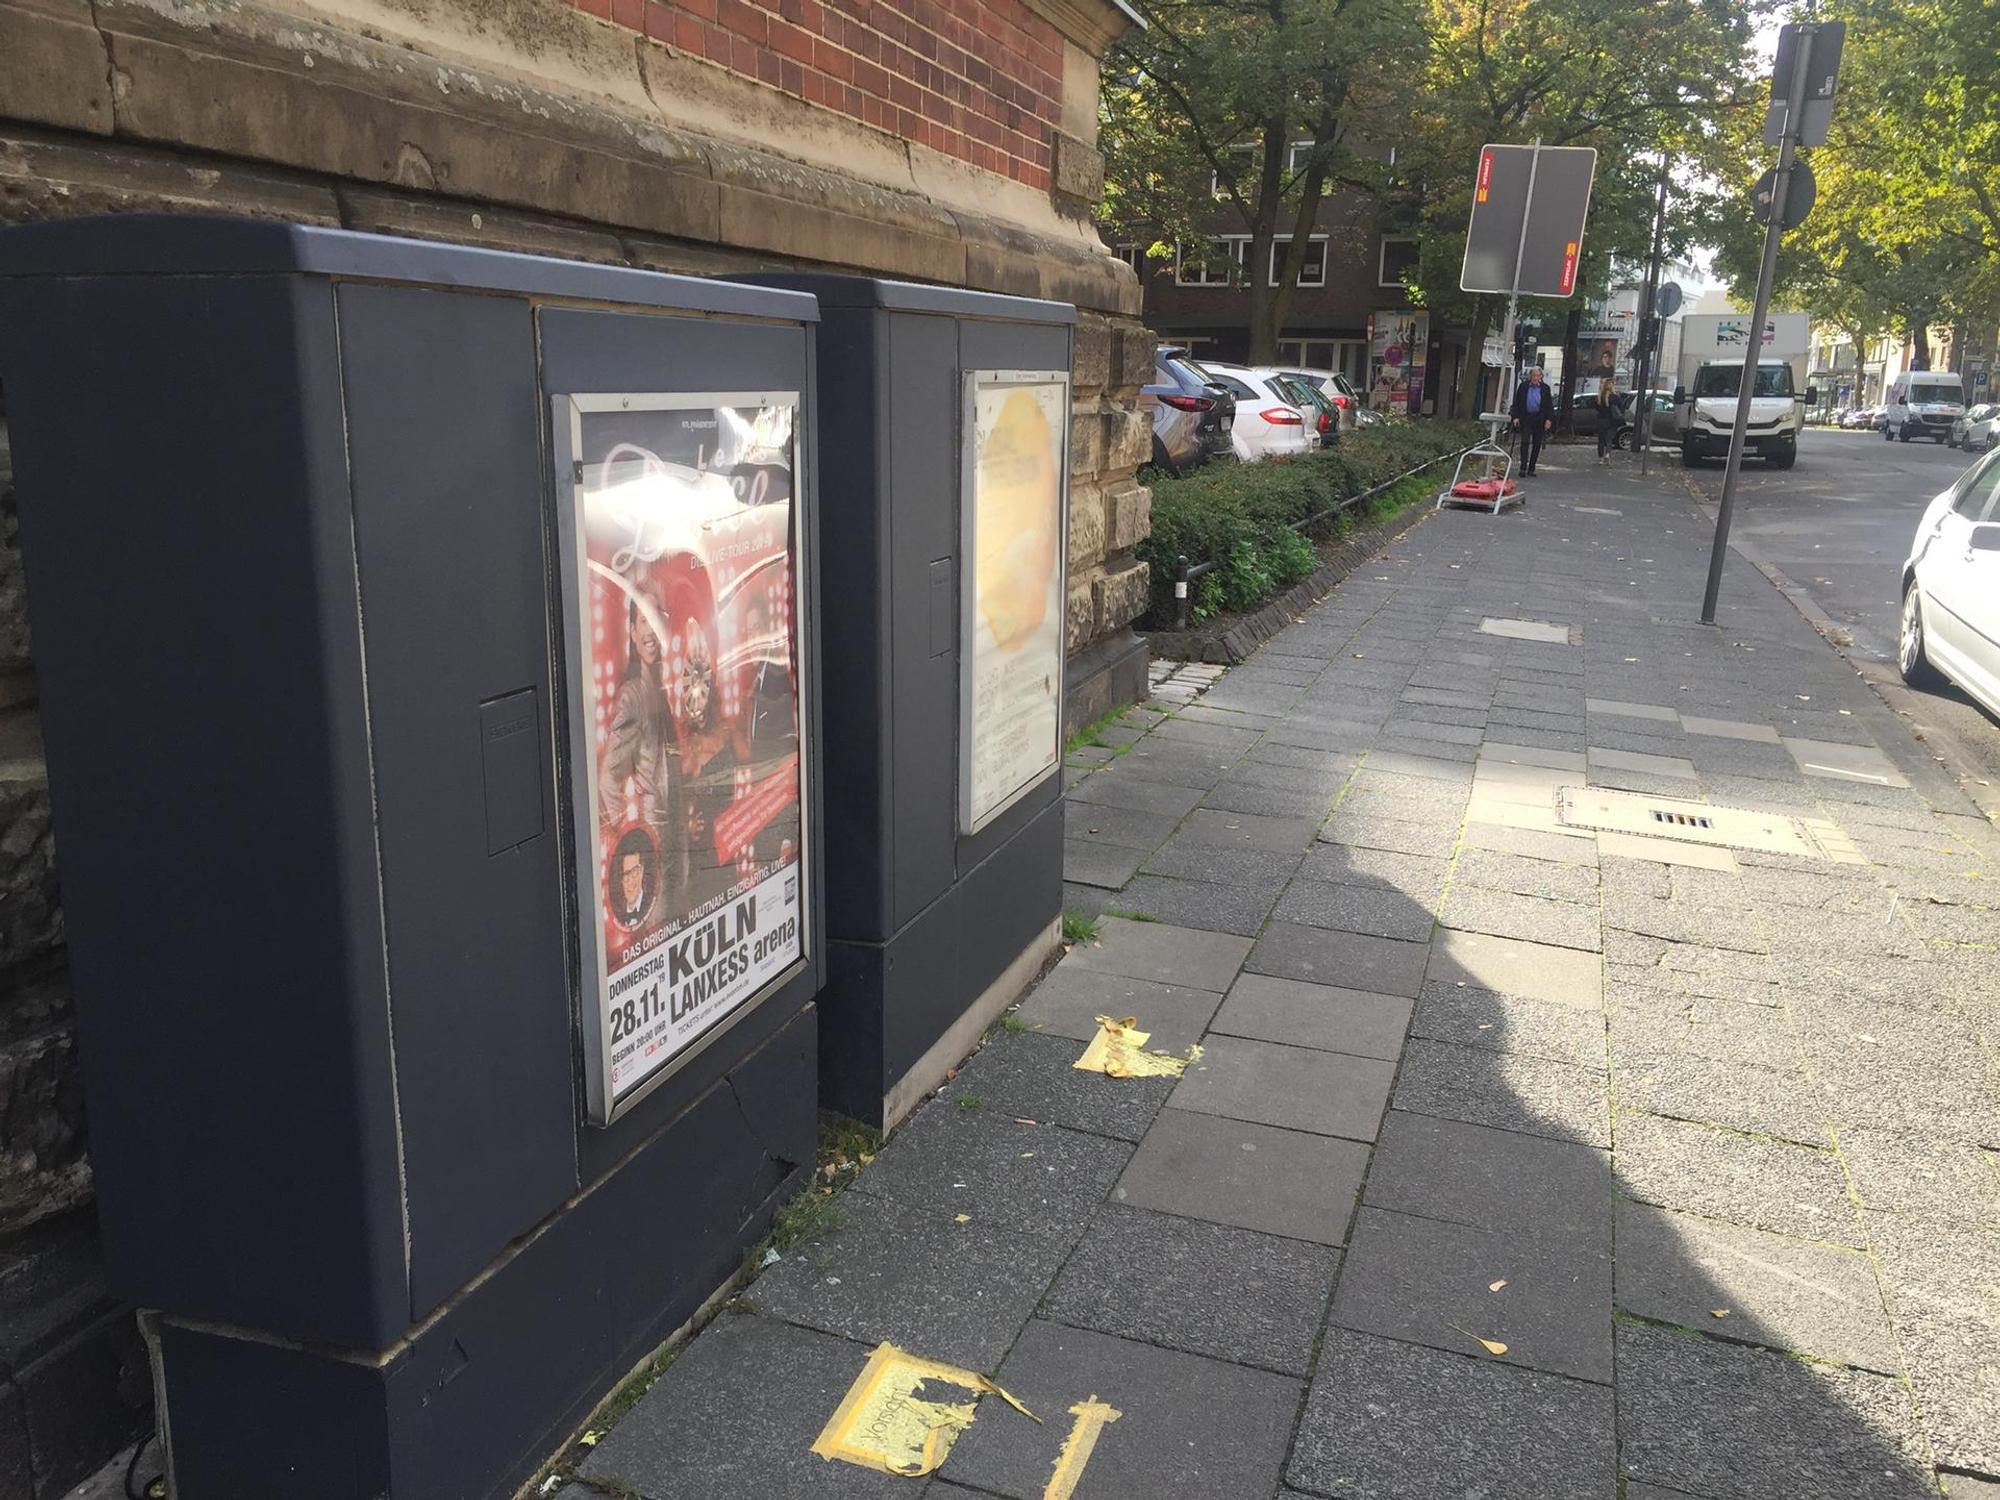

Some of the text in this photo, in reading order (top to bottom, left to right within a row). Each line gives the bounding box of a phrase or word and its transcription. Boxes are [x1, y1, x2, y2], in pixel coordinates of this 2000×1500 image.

[622, 942, 641, 963] DAS
[643, 918, 682, 951] ORIGINAL
[609, 953, 665, 1000] DONNERSTAG
[670, 917, 795, 1025] LANXESS arena
[610, 982, 665, 1046] 28.11.
[678, 1013, 700, 1035] TICKETS
[612, 1042, 635, 1066] BEGINN
